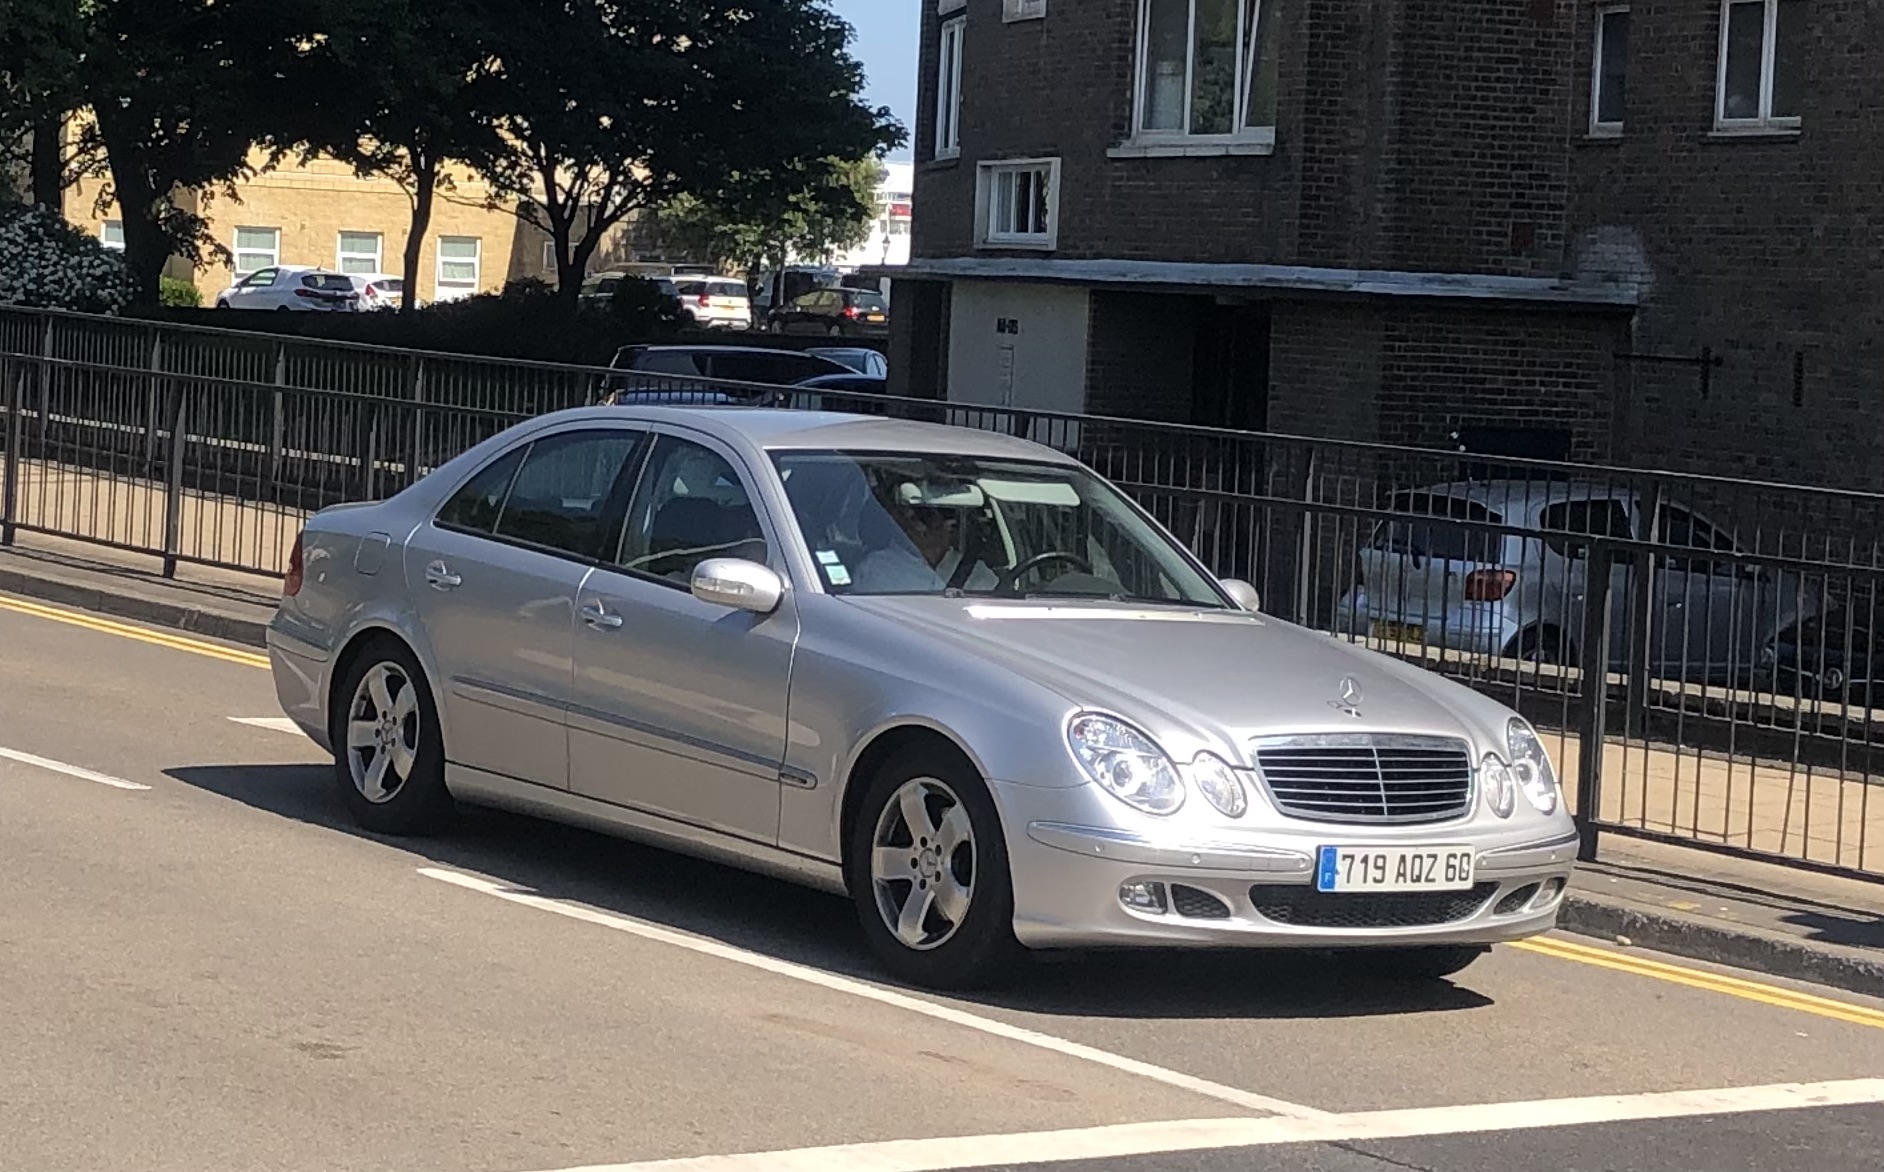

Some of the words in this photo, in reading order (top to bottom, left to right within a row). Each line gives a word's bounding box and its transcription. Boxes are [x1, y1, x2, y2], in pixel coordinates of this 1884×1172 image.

[1341, 854, 1387, 884] 719
[1395, 853, 1438, 884] AQZ
[1444, 853, 1471, 882] 60
